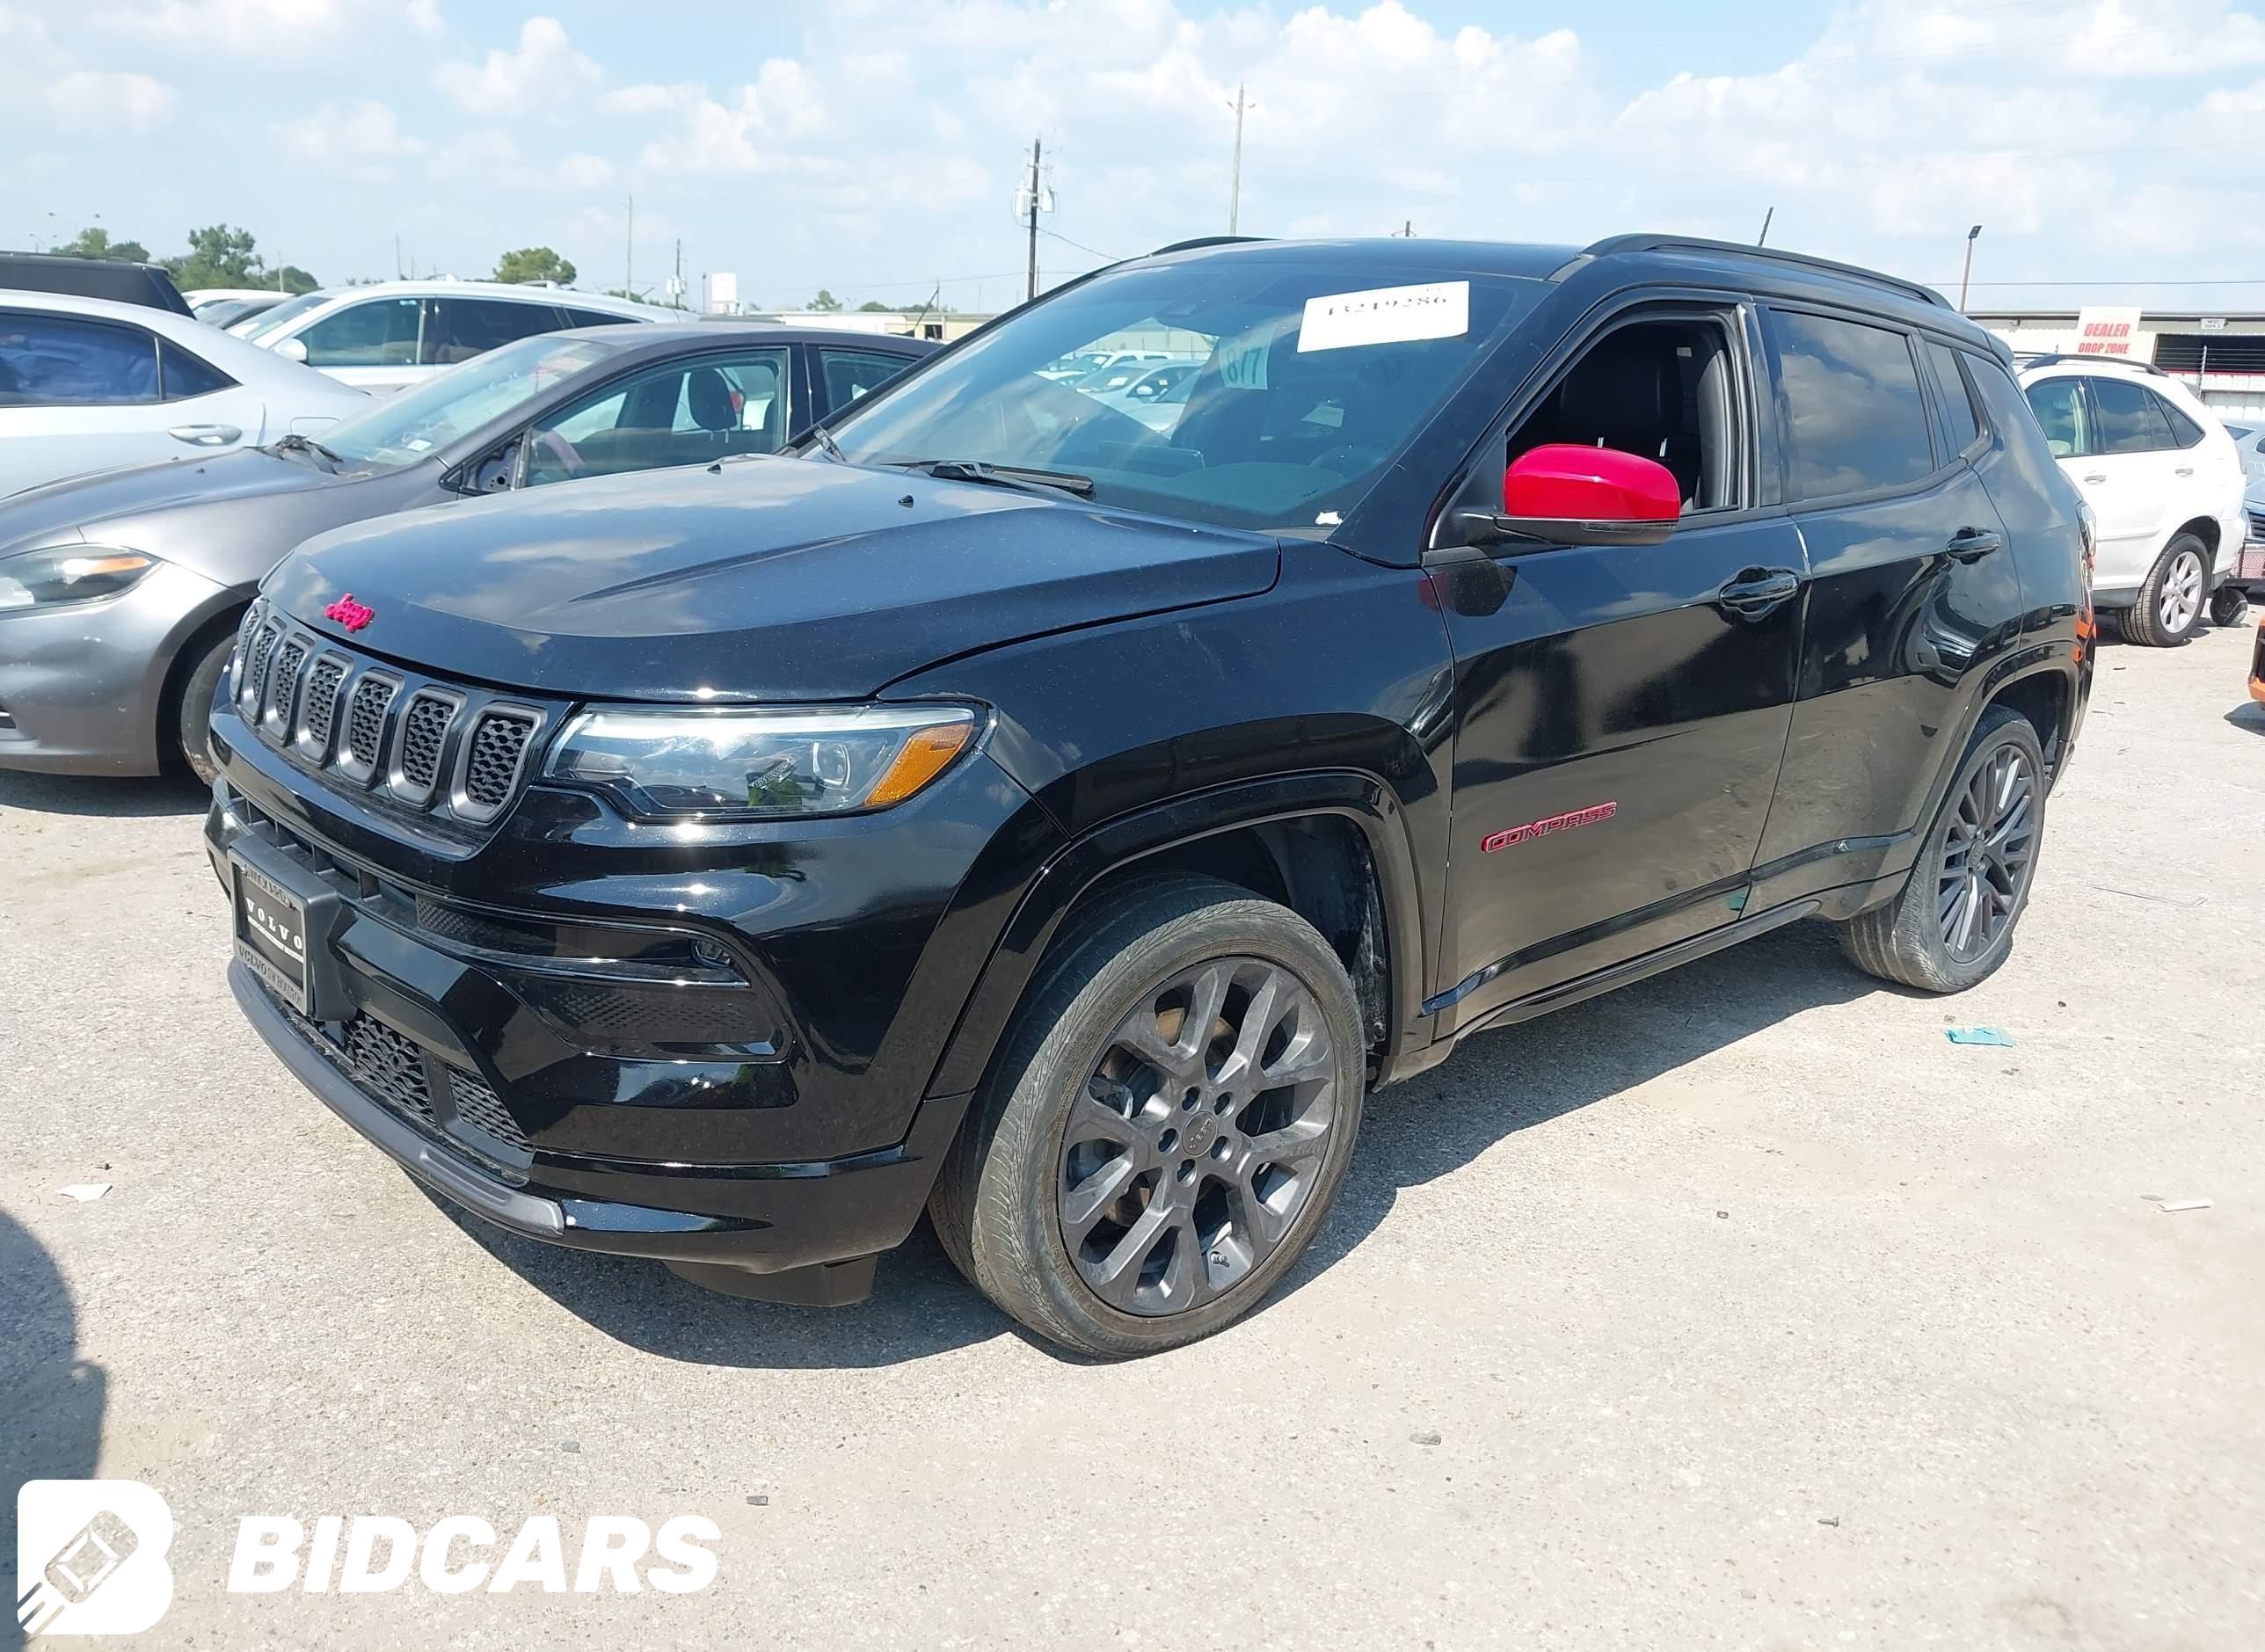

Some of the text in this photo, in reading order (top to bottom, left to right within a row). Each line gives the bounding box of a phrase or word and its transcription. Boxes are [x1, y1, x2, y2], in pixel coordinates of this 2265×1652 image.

[2084, 323, 2130, 337] DEALER
[2078, 342, 2130, 354] DROP ZONE
[1481, 800, 1618, 853] COMPASS
[246, 897, 302, 950] VOLVO
